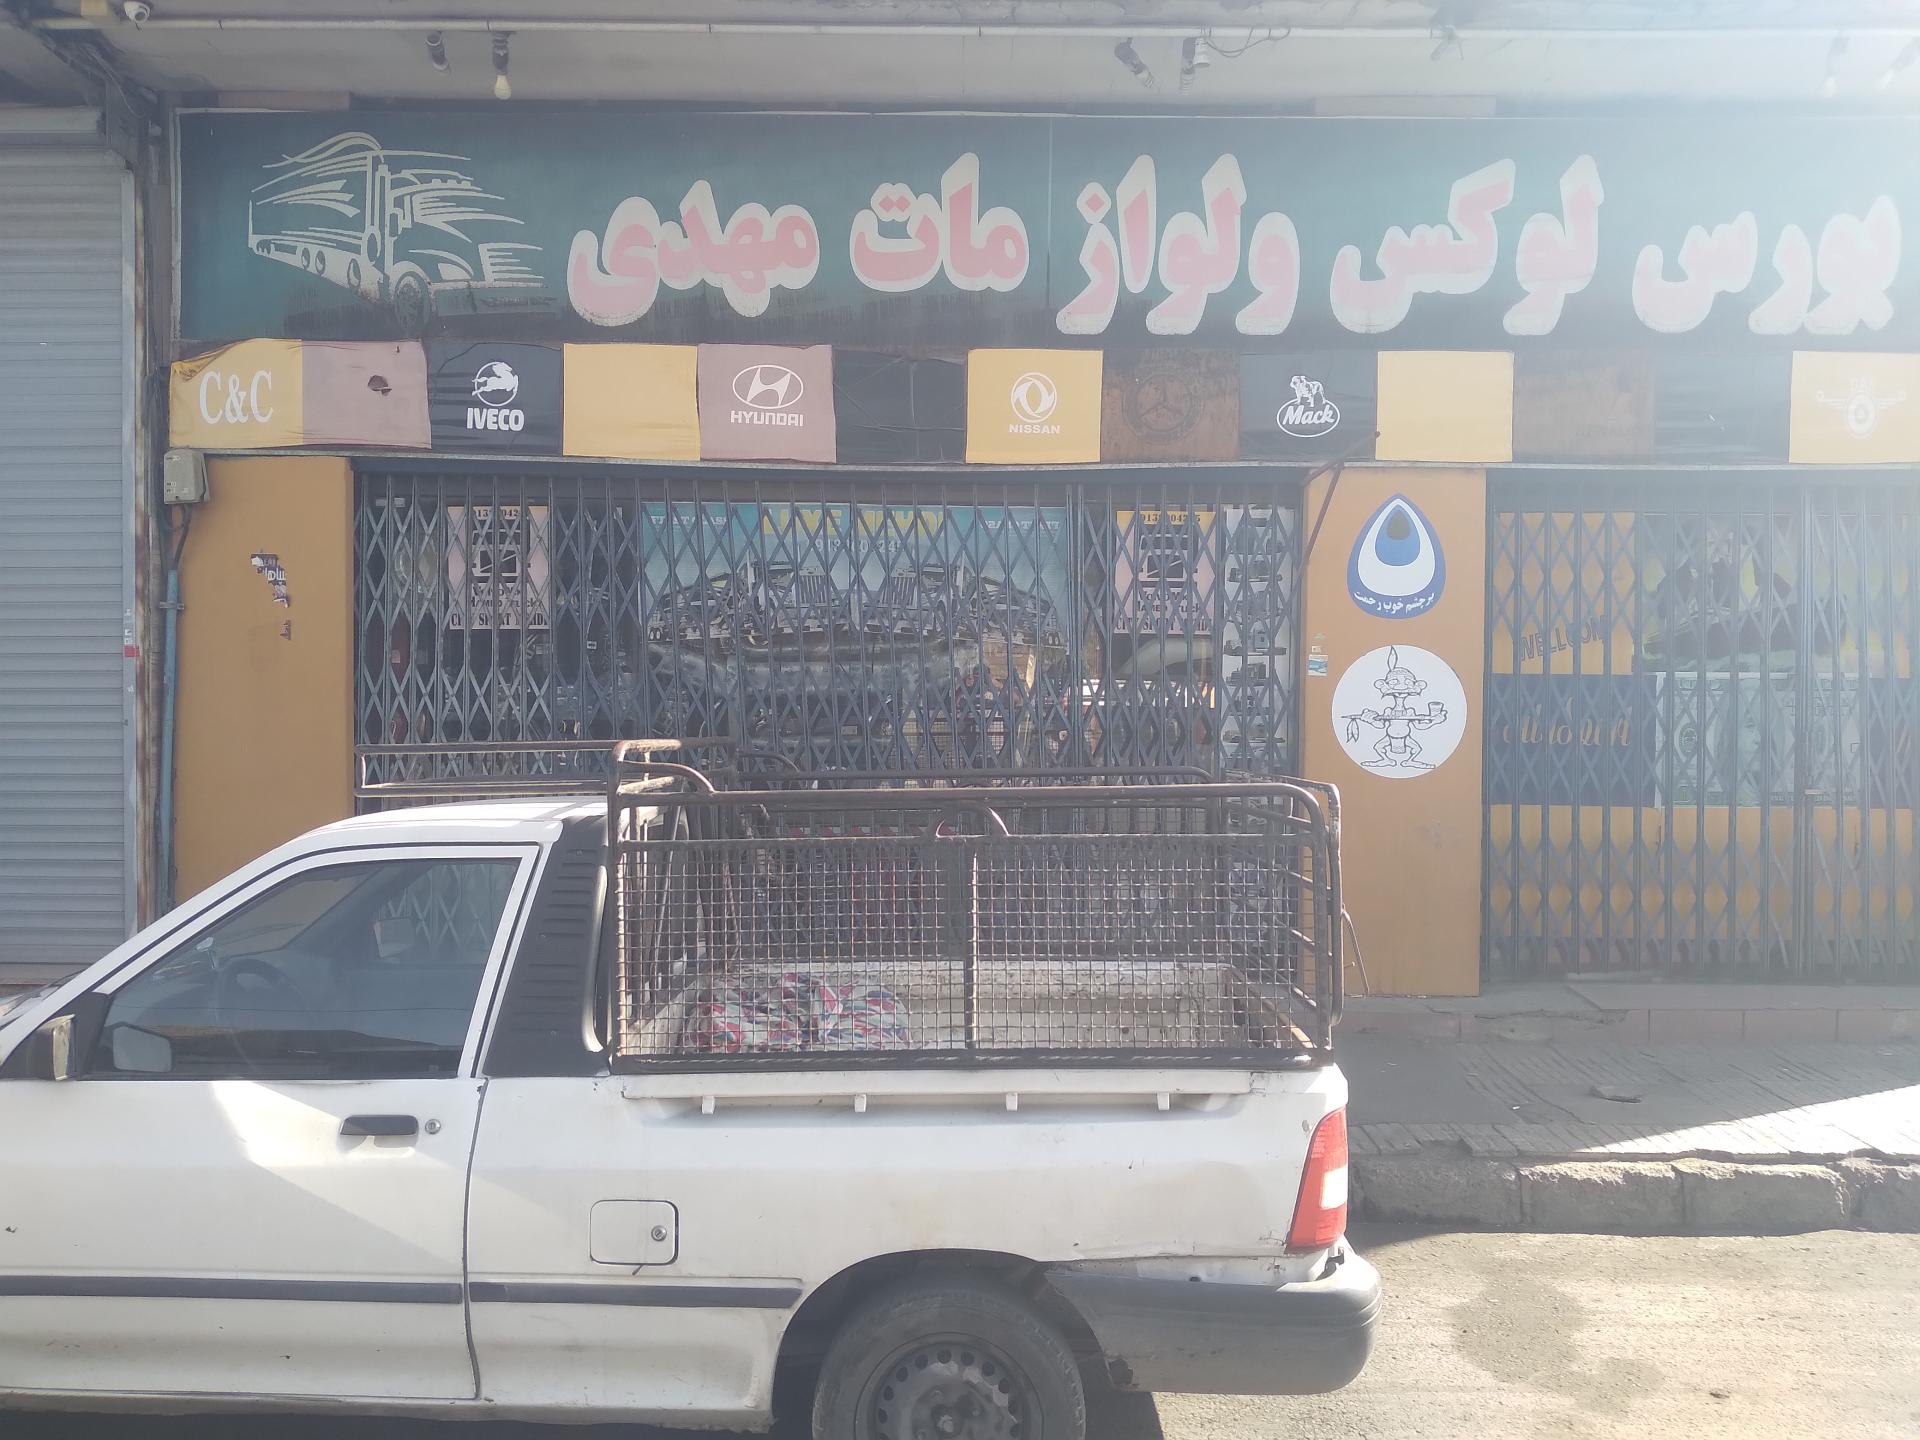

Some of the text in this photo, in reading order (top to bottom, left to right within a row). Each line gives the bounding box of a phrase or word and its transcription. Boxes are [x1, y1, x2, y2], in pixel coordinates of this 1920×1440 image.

[566, 178, 820, 328] مهدی
[1330, 154, 1605, 336] لوکس
[1632, 194, 1902, 336] بورس
[199, 370, 274, 424] C&C
[1282, 404, 1335, 425] Mack
[466, 407, 525, 432] IVECO
[730, 410, 804, 427] HYUNDAI
[1009, 423, 1061, 434] NISSAN
